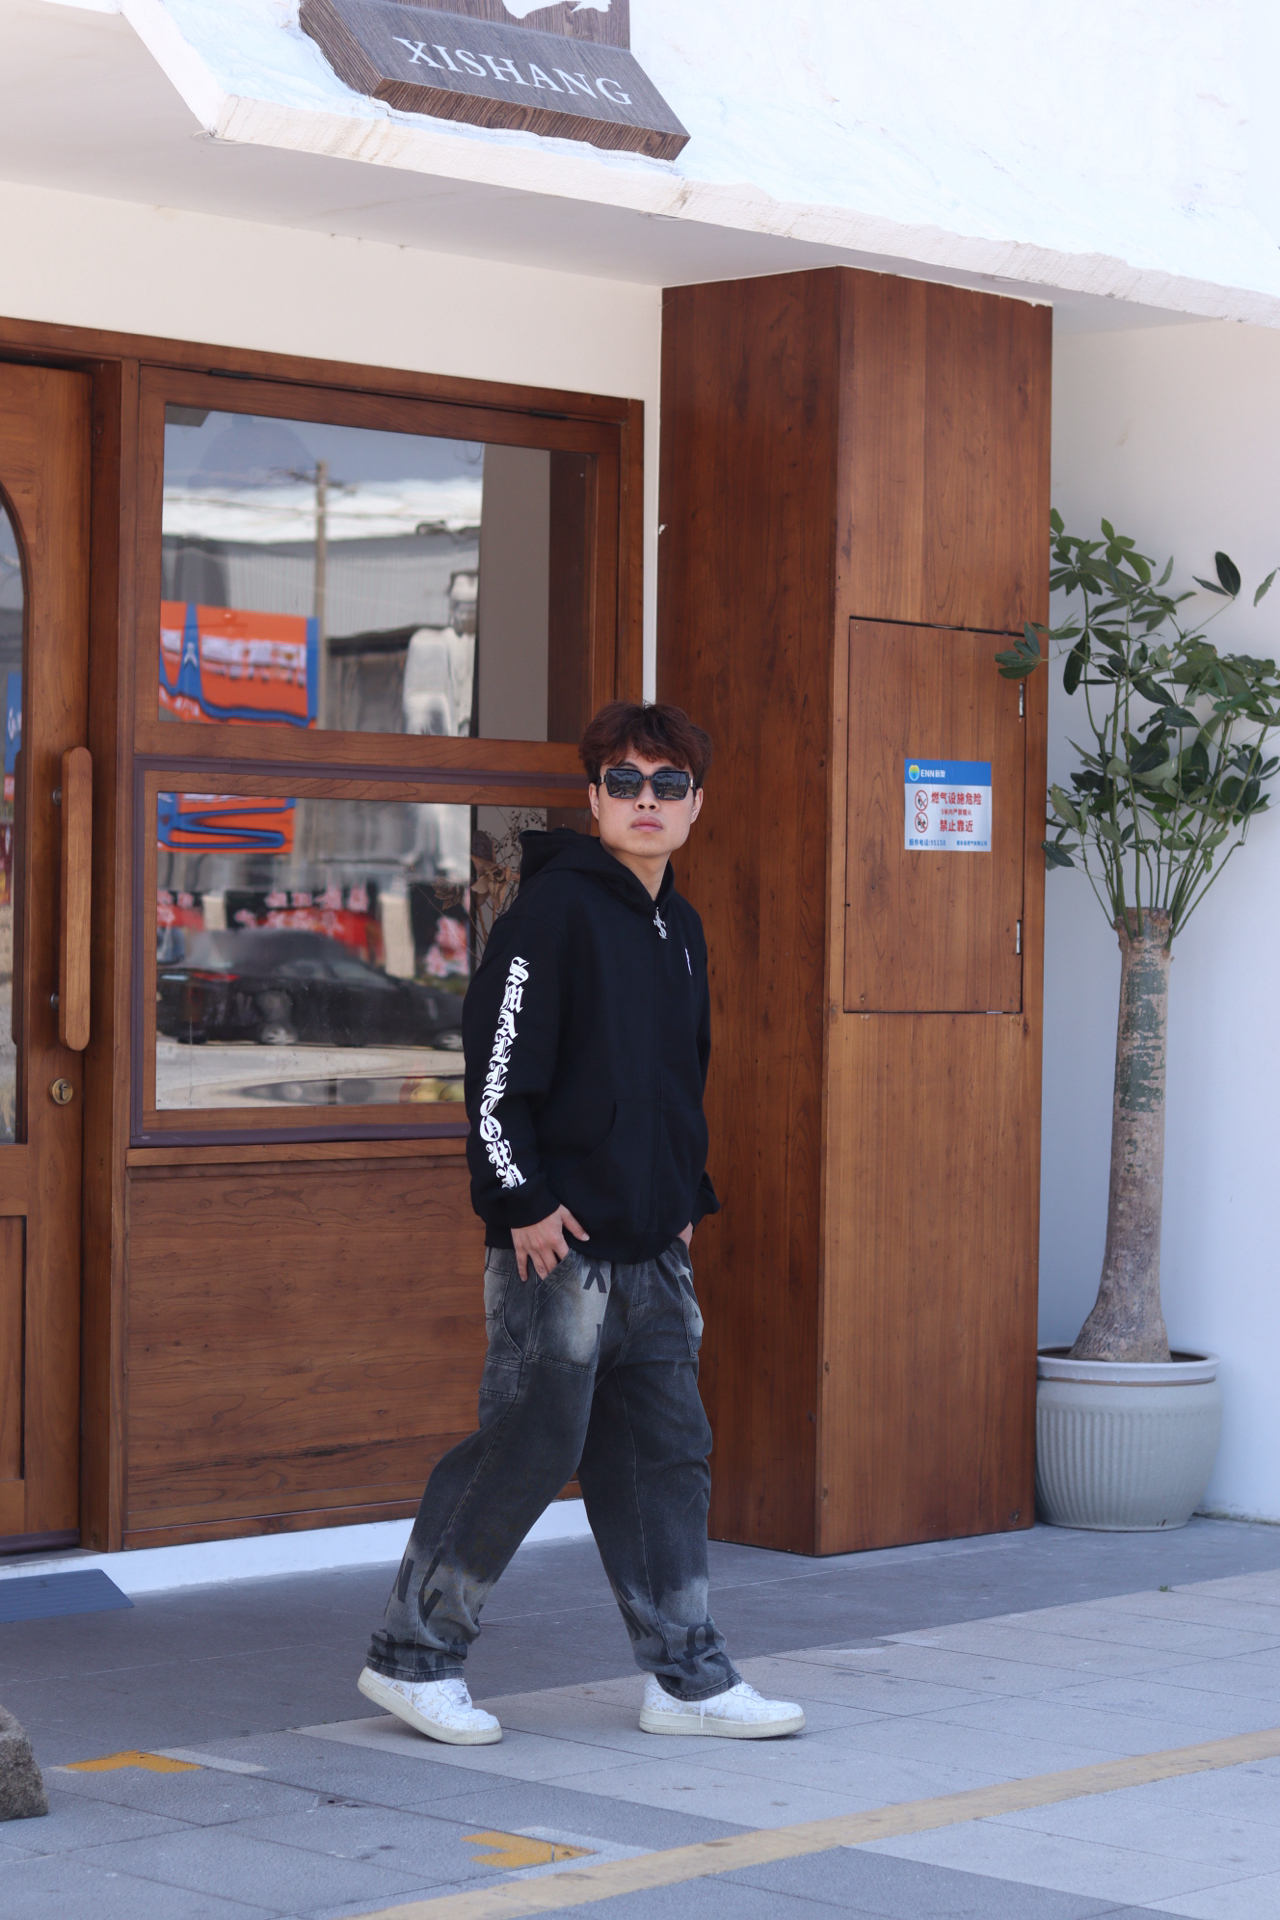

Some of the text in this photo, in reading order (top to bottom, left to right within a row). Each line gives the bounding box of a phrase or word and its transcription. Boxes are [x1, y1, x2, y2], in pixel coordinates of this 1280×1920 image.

[392, 36, 633, 106] XISHANG
[920, 769, 935, 778] ENN
[931, 791, 982, 805] 燃气设施危险
[939, 819, 973, 833] 禁止靠近
